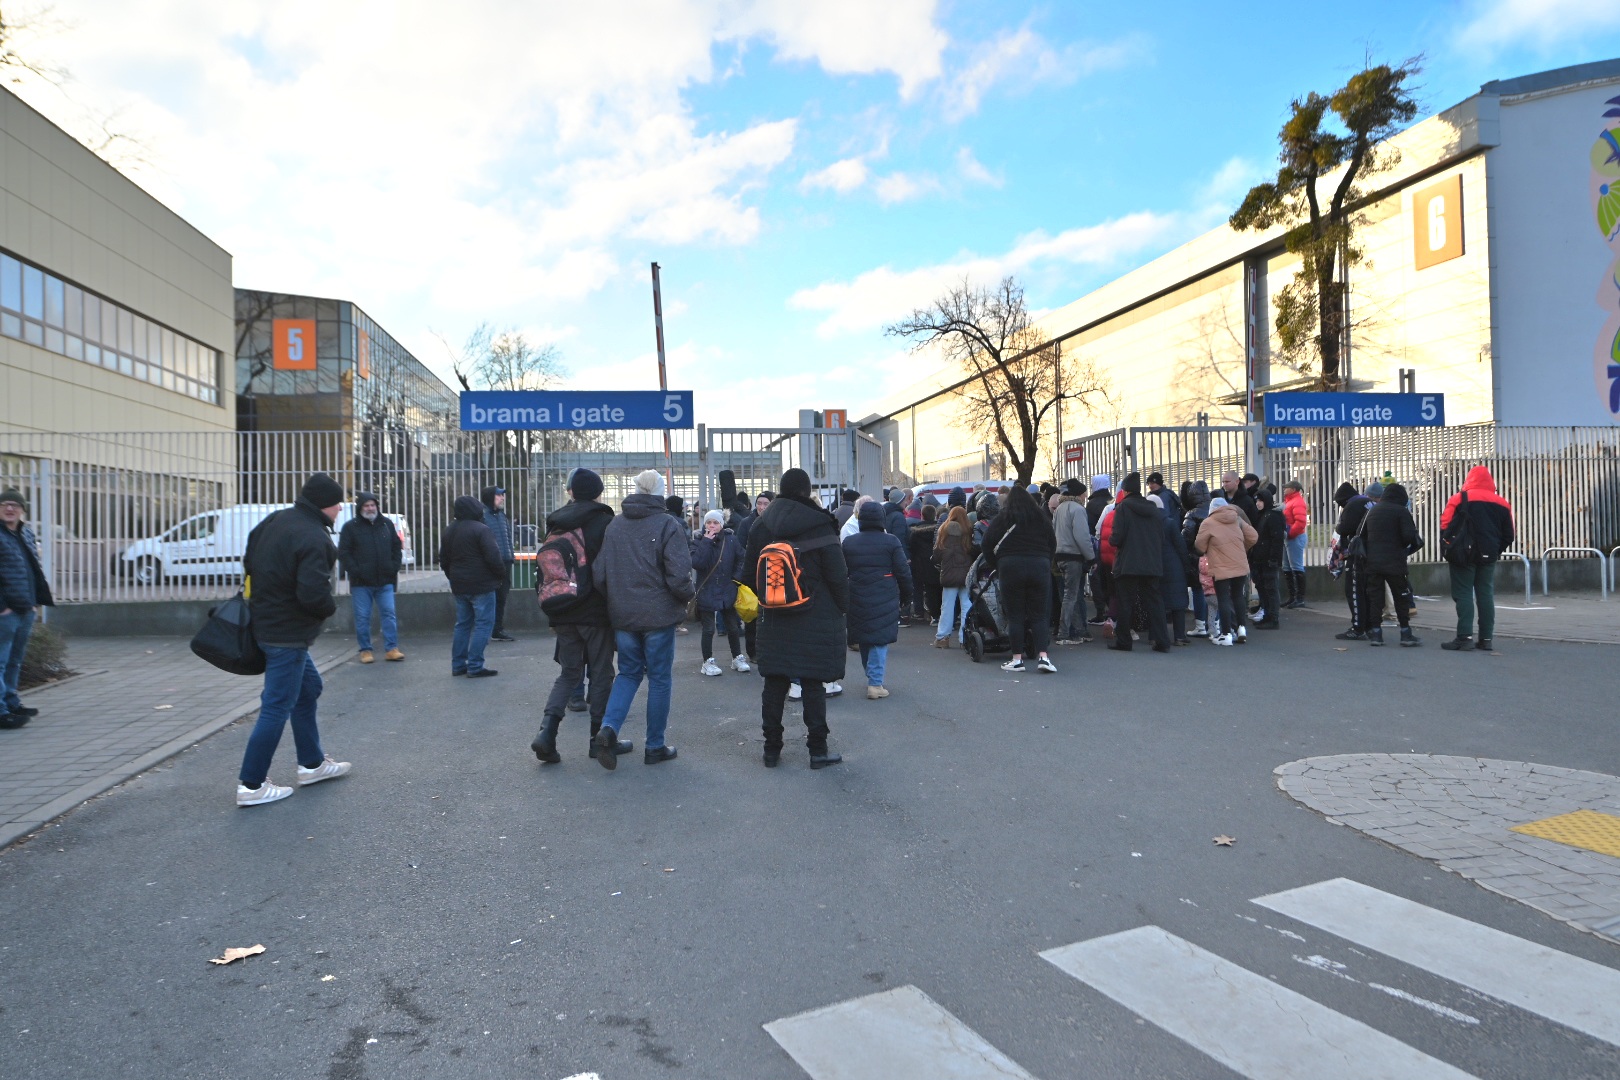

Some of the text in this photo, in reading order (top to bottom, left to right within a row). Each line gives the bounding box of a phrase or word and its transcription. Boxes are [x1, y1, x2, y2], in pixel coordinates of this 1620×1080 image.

[1428, 195, 1446, 251] 6
[288, 328, 303, 361] 5
[471, 404, 550, 423] brama
[571, 404, 625, 427] gate
[662, 394, 683, 422] 5
[1274, 403, 1335, 421] brama
[1351, 404, 1393, 424] gate
[1421, 396, 1437, 420] 5
